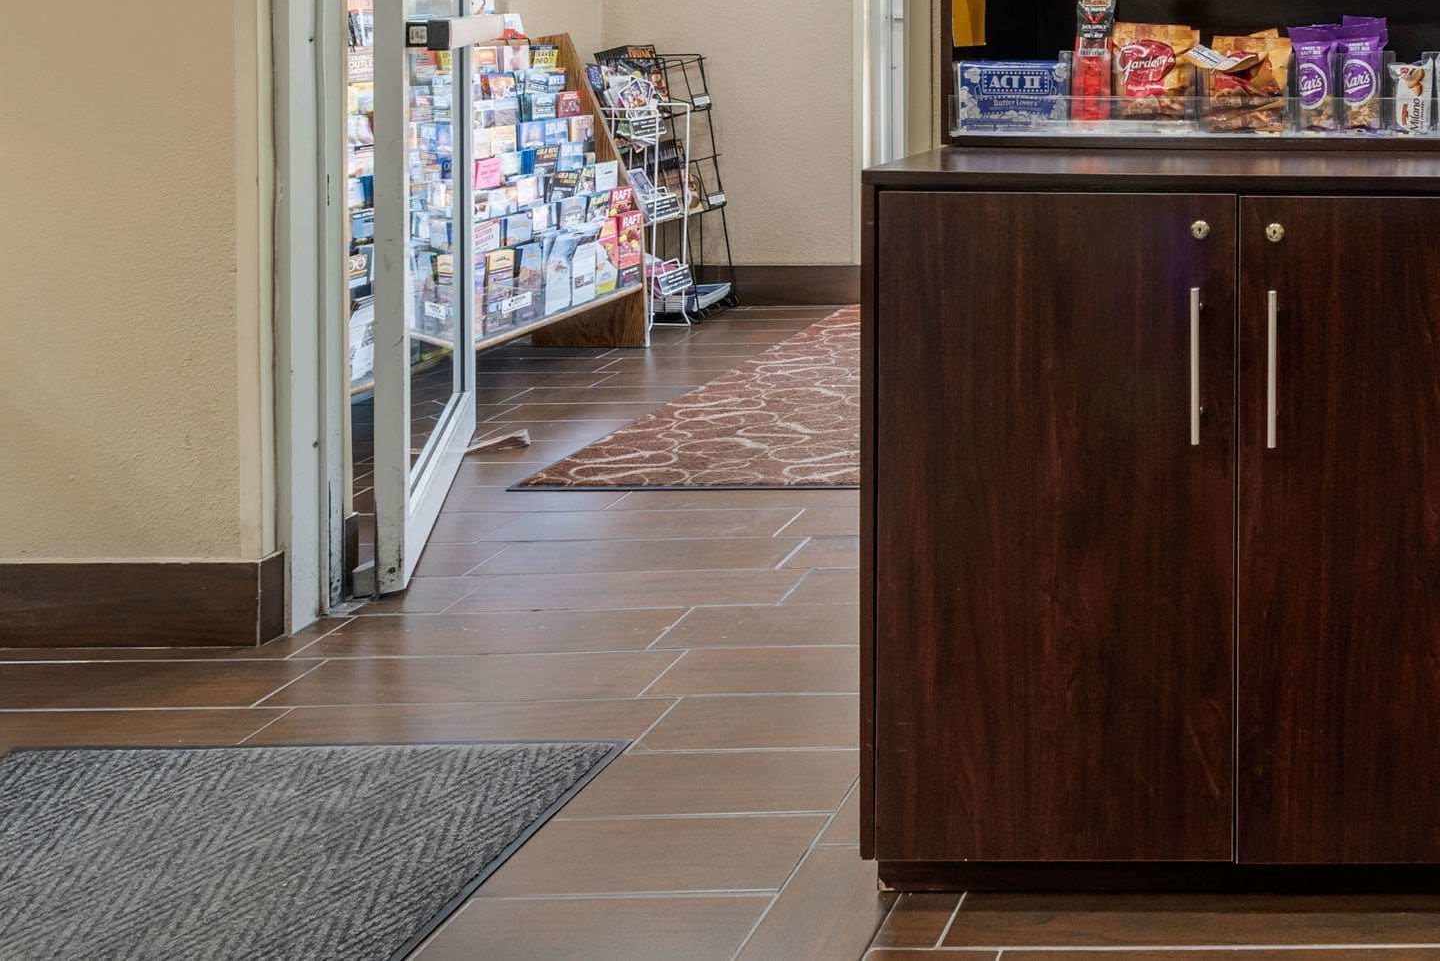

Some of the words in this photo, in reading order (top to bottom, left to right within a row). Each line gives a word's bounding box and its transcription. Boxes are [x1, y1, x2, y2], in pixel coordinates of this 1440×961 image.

[988, 75, 1020, 88] ACT
[1023, 75, 1042, 88] II
[1408, 97, 1421, 132] Milano
[613, 187, 632, 200] RAFT
[623, 214, 640, 228] RAFT
